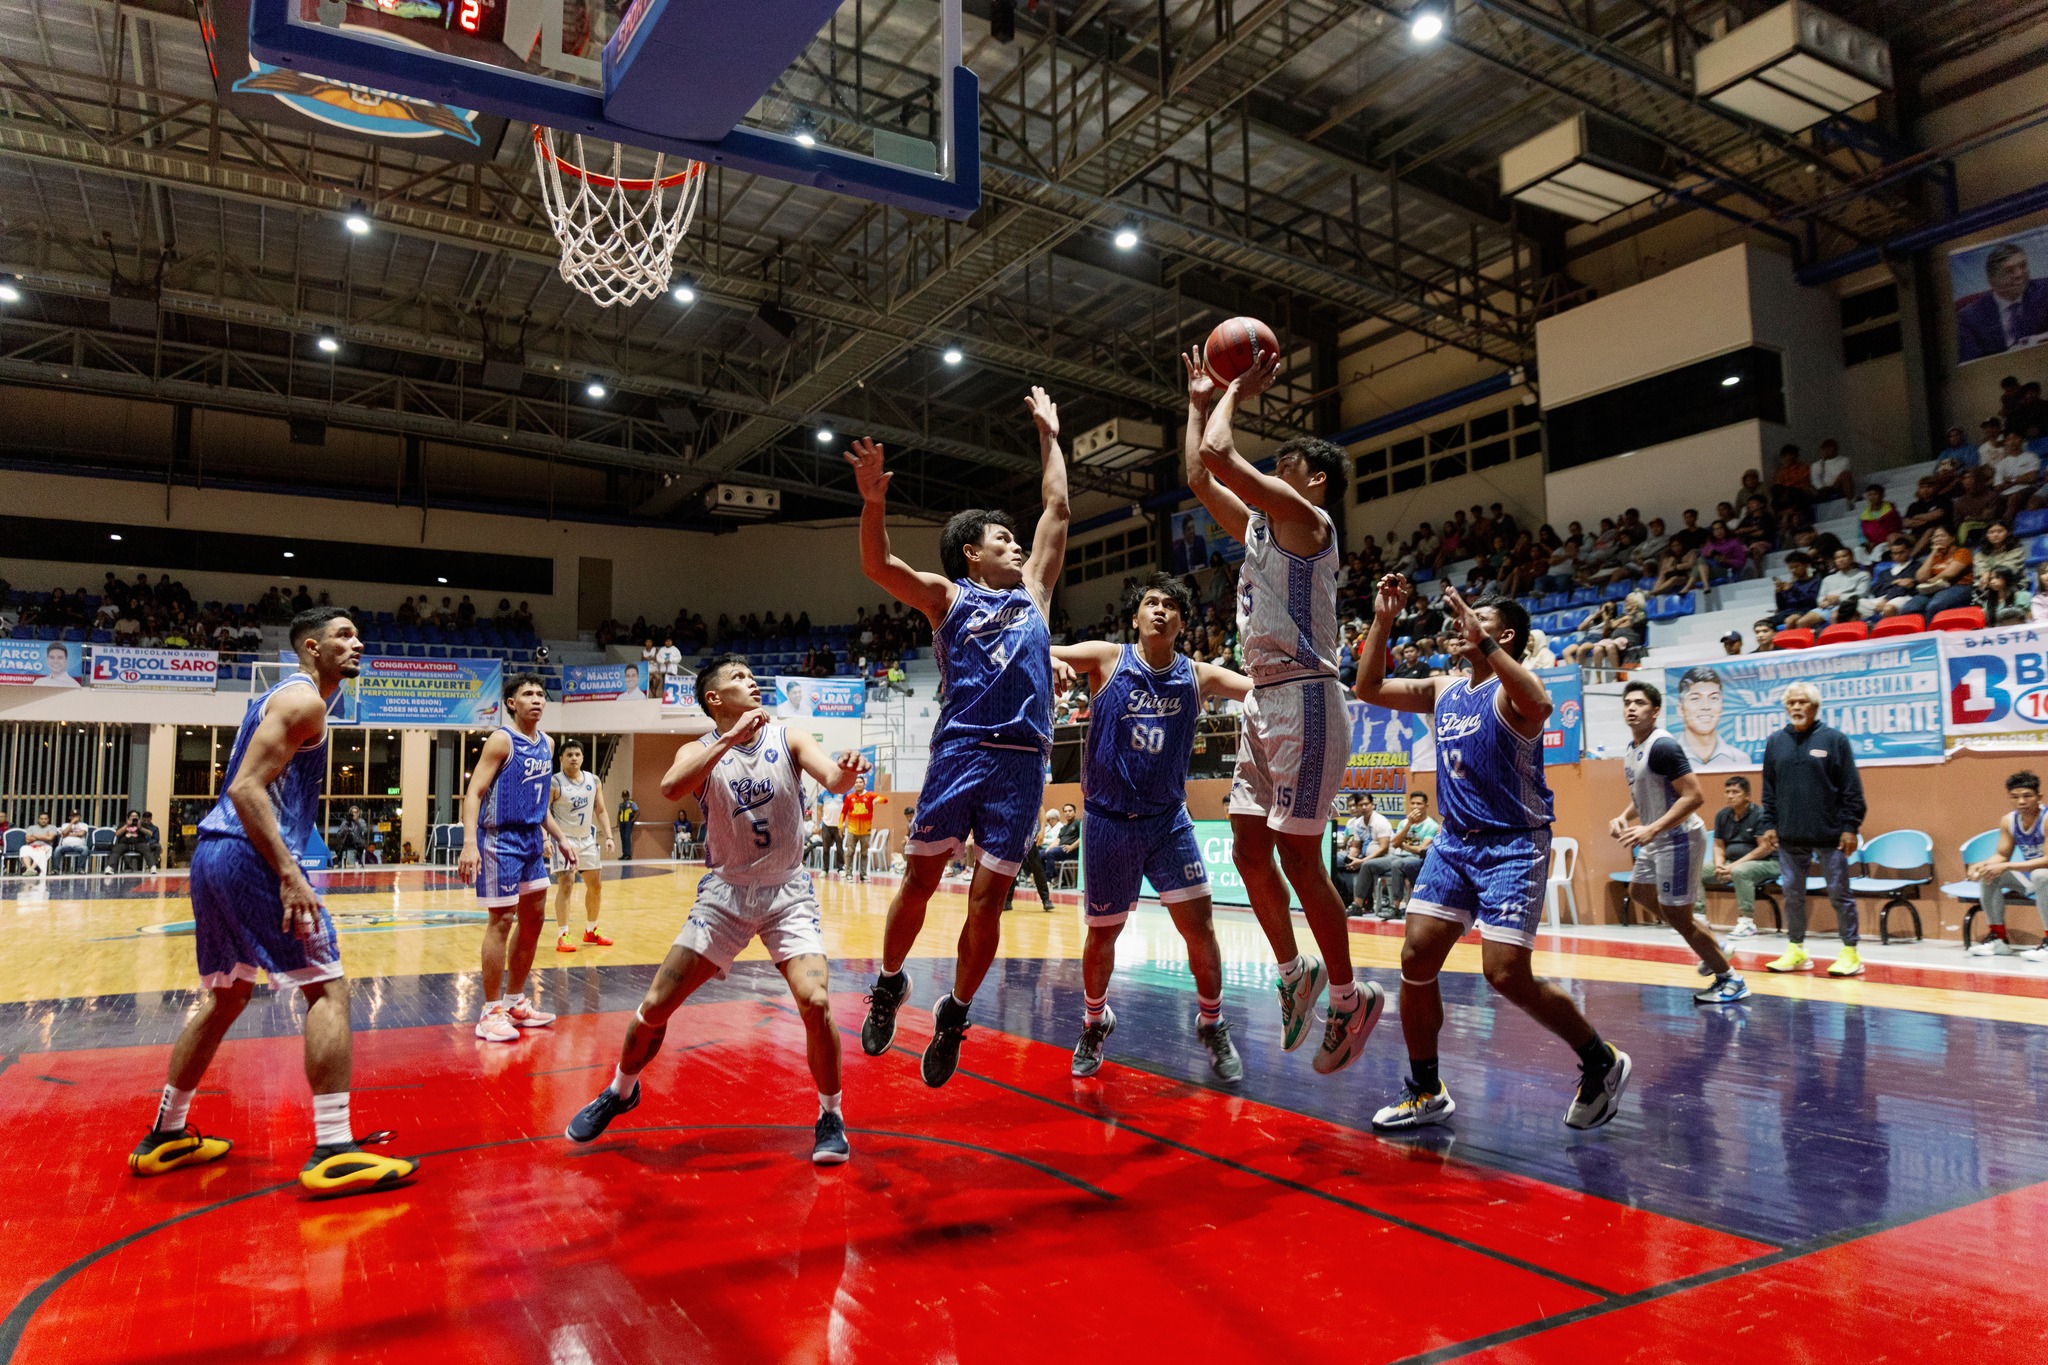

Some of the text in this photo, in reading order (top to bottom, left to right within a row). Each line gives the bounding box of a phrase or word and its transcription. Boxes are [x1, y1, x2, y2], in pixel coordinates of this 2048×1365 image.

[1964, 630, 2039, 648] BASTA
[0, 648, 40, 660] ARCO
[373, 661, 457, 671] CONGRATULATIONS!
[1758, 664, 1776, 681] AN
[1868, 650, 1911, 670] AGILA
[124, 672, 138, 680] 10
[587, 672, 620, 680] MARCO
[392, 679, 471, 690] VILLAFUERTE
[580, 680, 622, 690] GUMABAO
[362, 690, 416, 698] PERFORMING
[822, 694, 851, 704] LRAY
[1126, 689, 1182, 717] Iriga
[1131, 723, 1166, 754] 60
[1864, 739, 1874, 750] 5
[1346, 752, 1409, 767] ASKETBALL
[1340, 768, 1405, 790] AMENT
[534, 783, 543, 804] 7
[729, 777, 774, 808] Goa
[1276, 785, 1293, 808] 15
[578, 813, 584, 826] 7
[752, 818, 772, 848] 5
[1184, 861, 1204, 880] 60
[1662, 882, 1670, 892] 9
